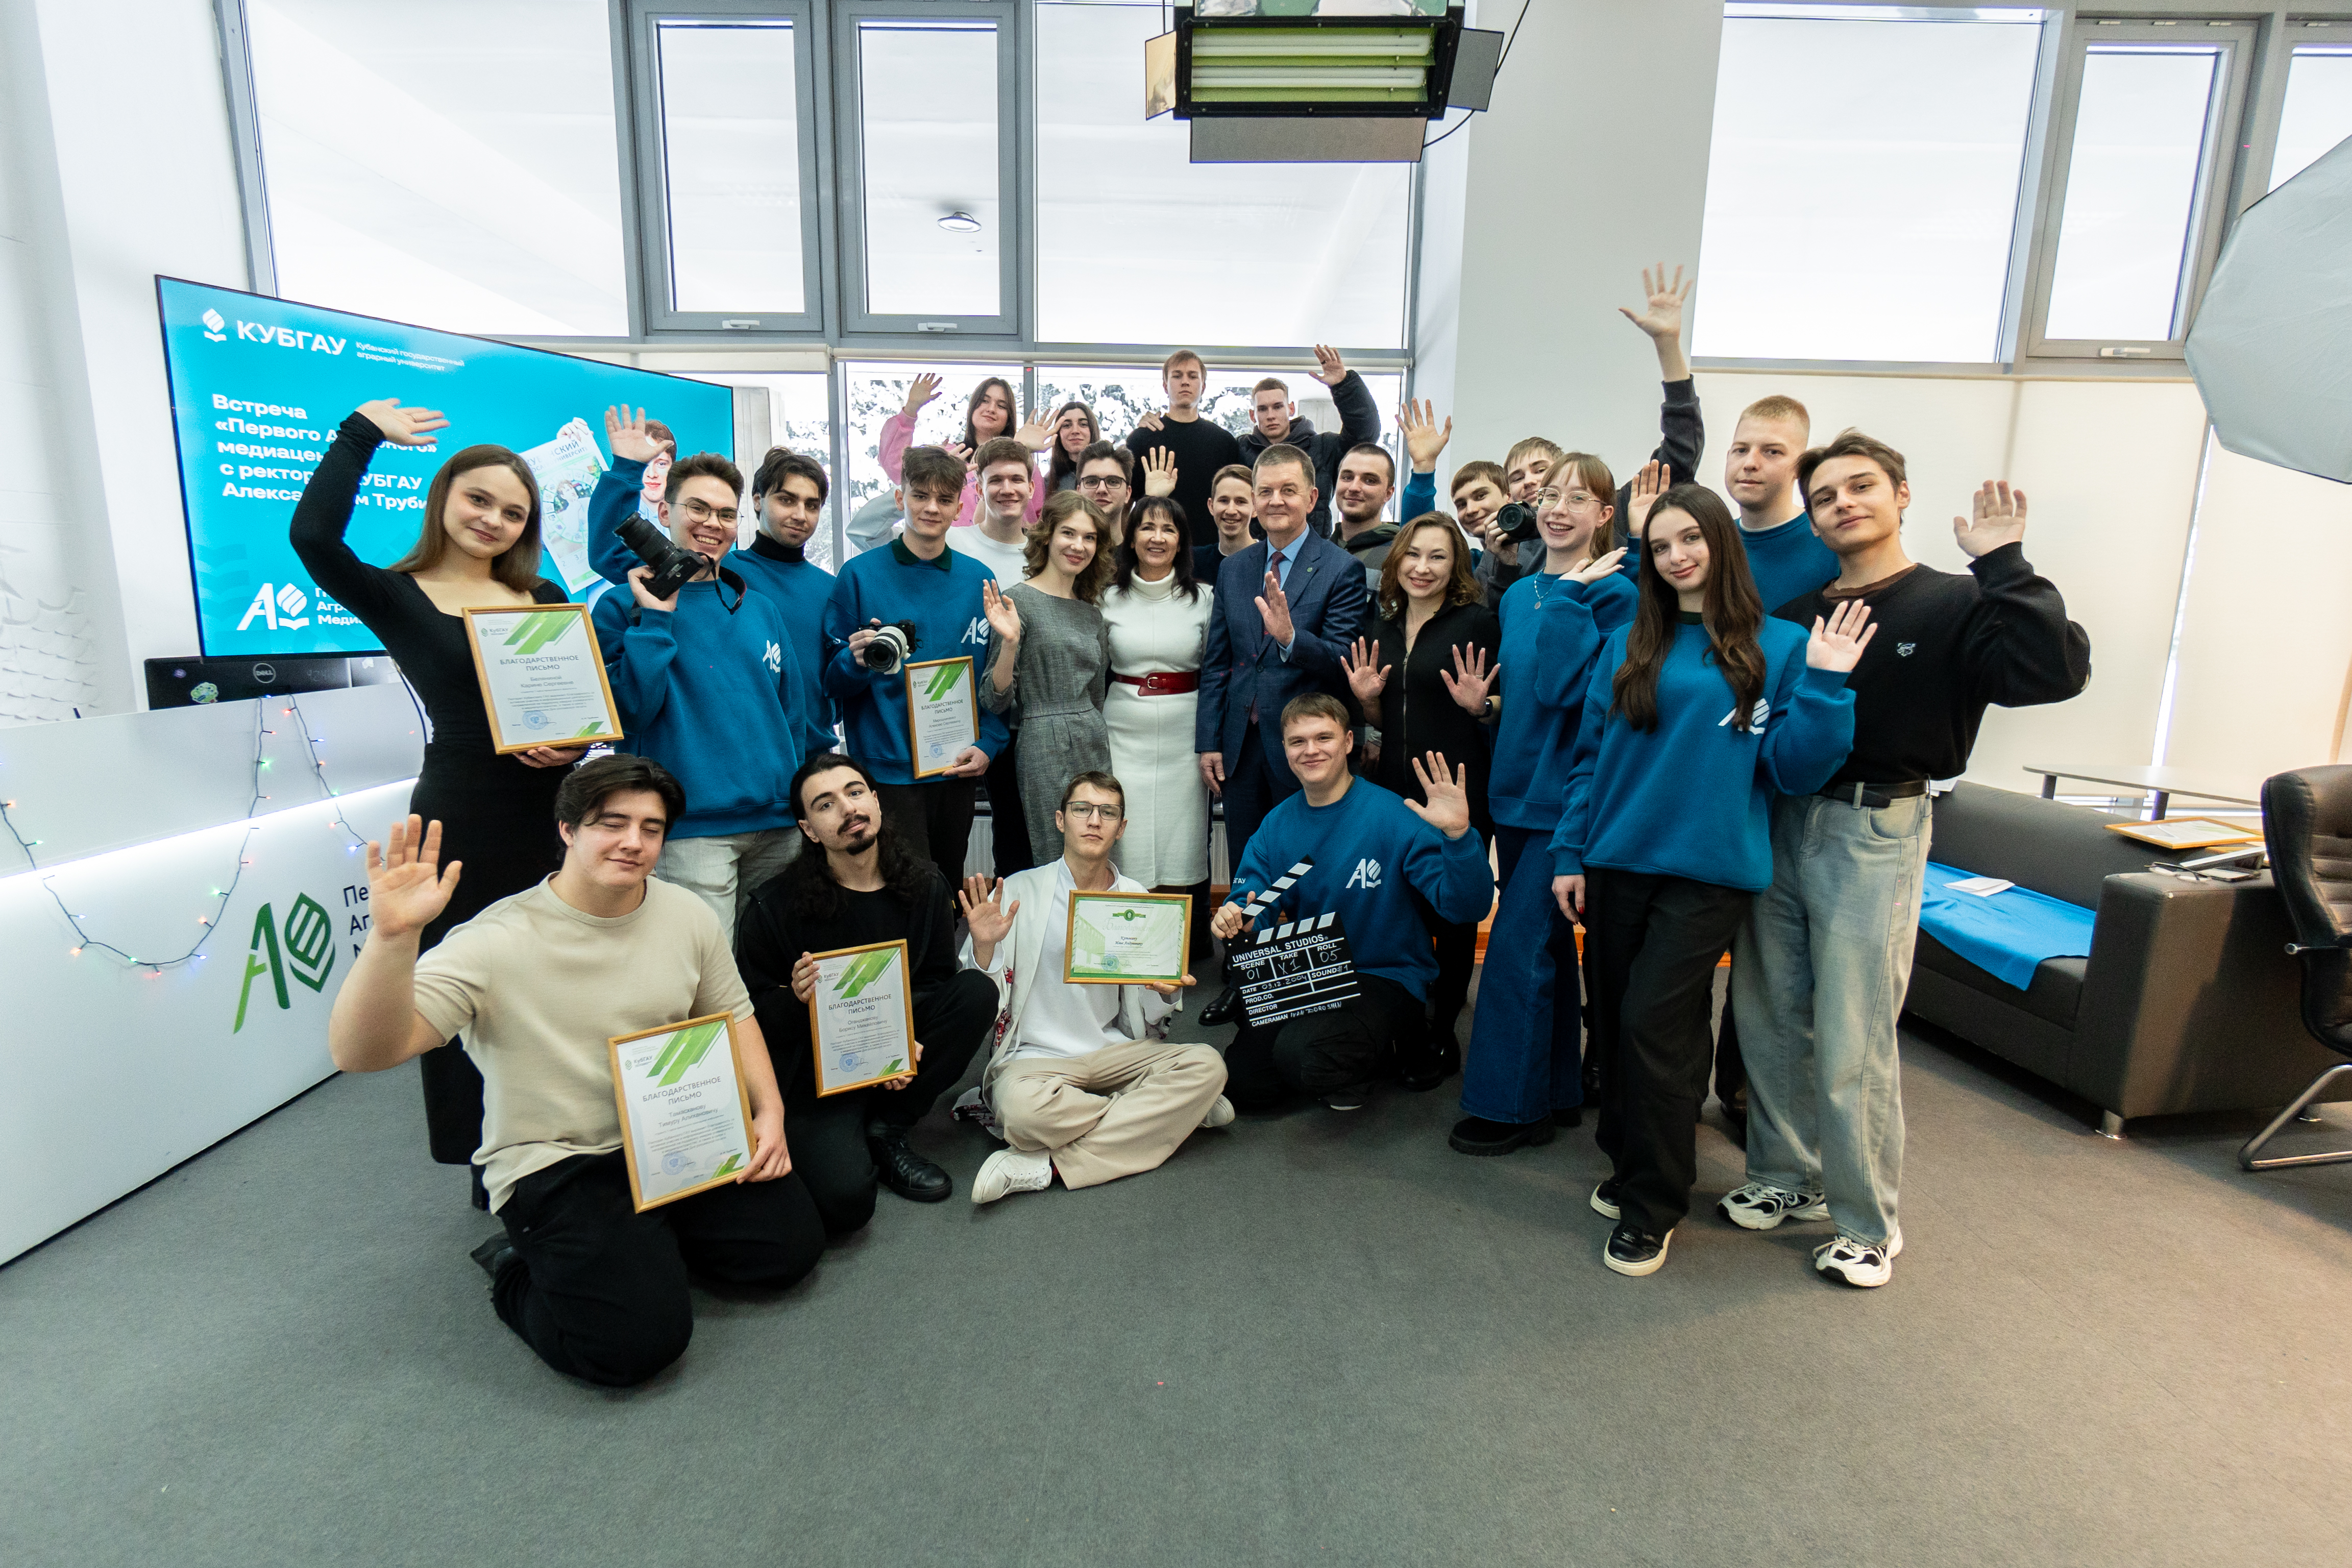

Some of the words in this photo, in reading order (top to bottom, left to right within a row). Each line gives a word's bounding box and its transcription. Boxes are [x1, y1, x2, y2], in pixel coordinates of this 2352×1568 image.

[237, 320, 347, 355] КУБГАУ
[356, 342, 399, 355] Кубанский
[400, 351, 464, 366] государственный
[357, 352, 396, 363] аграрный
[397, 359, 445, 371] университет
[212, 394, 308, 419] Встреча
[215, 418, 321, 441] «Первого
[219, 463, 234, 476] с
[359, 473, 422, 489] УБГАУ
[500, 655, 579, 665] БЛАГОДАРСТВЕННОЕ
[921, 699, 964, 710] БЛАГОДАРСТВЕННОЕ
[1233, 945, 1282, 963] UNIVERSAL
[1317, 943, 1337, 951] ROLL
[1279, 951, 1298, 961] TAKE
[1320, 948, 1342, 963] 05
[1241, 960, 1265, 970] SCENE
[829, 994, 892, 1010] БЛАГОДАРСТВЕННОЕ
[1245, 993, 1274, 1004] PROD.CO.
[848, 1005, 875, 1015] ПИСЬМО
[1248, 1003, 1278, 1015] DIRECTOR
[1252, 1014, 1288, 1027] CAMERAMAN
[643, 1076, 721, 1102] БЛАГОДАРСТВЕННОЕ
[668, 1091, 702, 1106] ПИСЬМО
